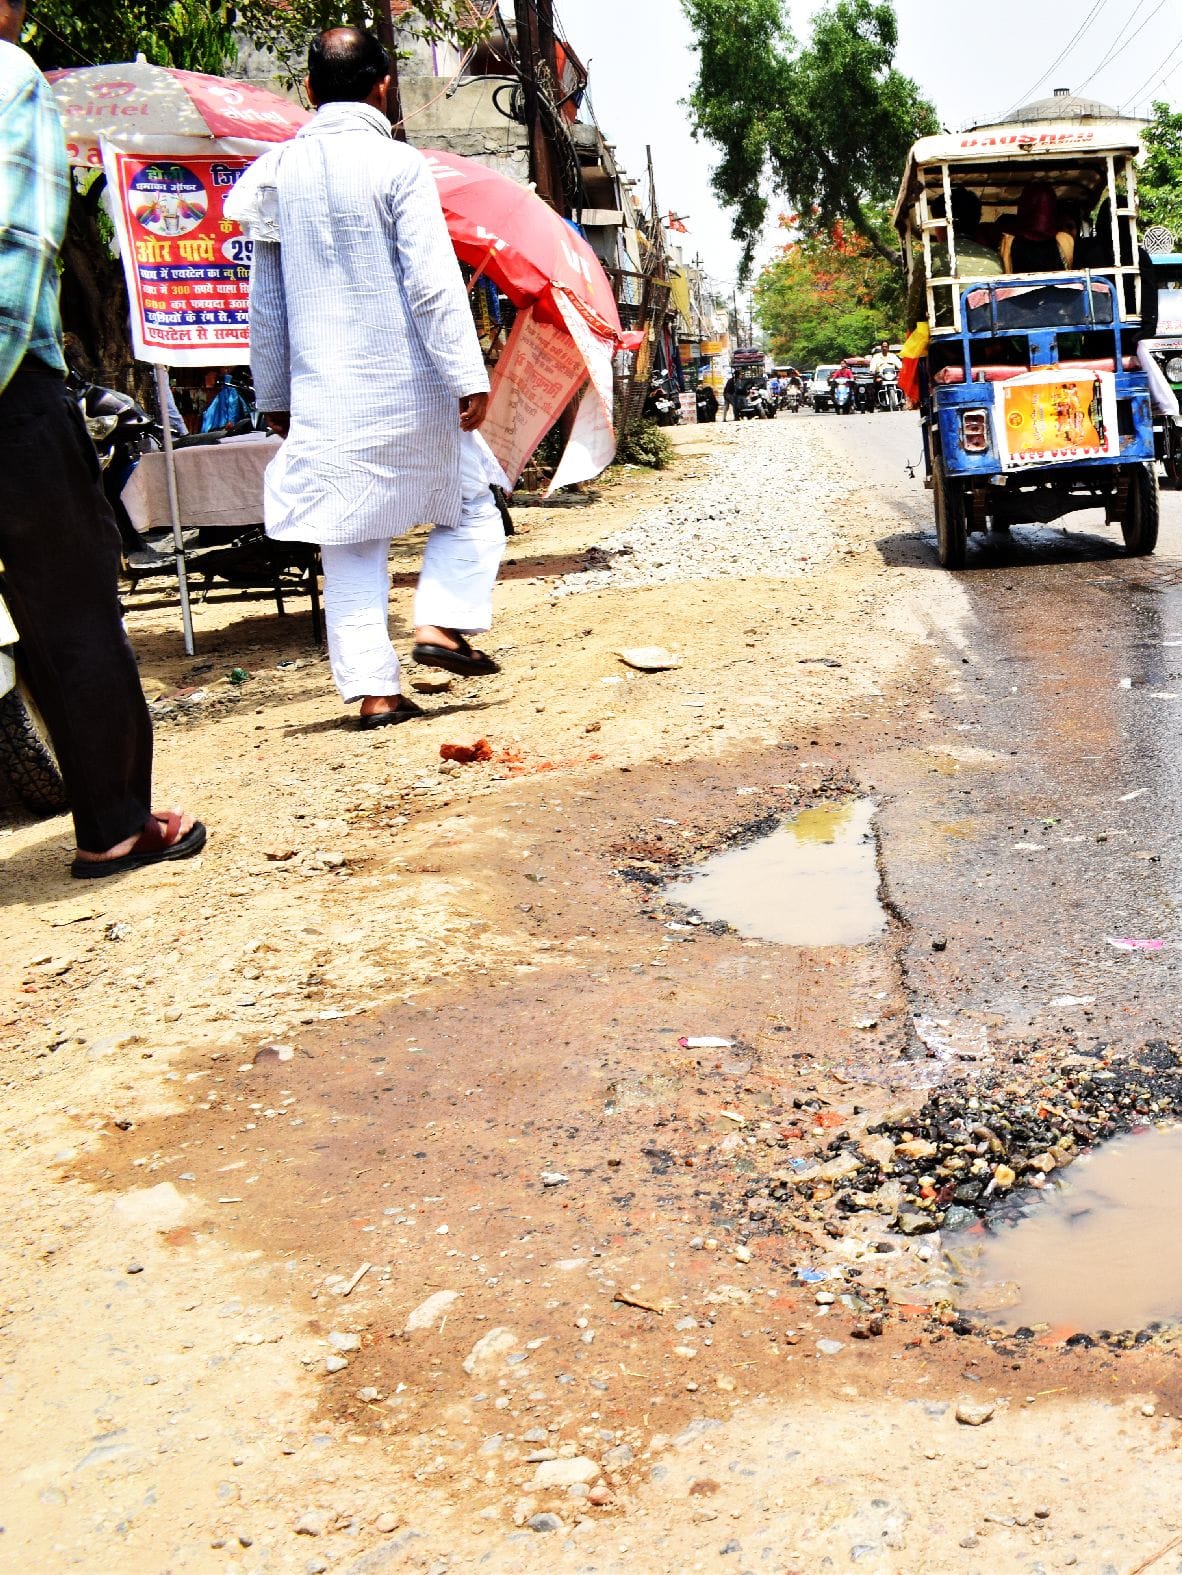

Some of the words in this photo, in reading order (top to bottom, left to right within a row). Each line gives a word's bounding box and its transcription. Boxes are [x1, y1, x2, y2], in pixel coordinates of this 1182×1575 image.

[65, 102, 149, 117] airtel
[146, 166, 184, 180] होली
[136, 183, 167, 191] धमाका
[136, 235, 171, 262] और
[177, 234, 216, 262] पायें
[160, 267, 169, 279] में
[171, 267, 204, 279] एयरटेल
[207, 268, 220, 278] का
[237, 267, 250, 278] सि
[216, 284, 237, 294] वाला
[239, 282, 250, 294] सि
[170, 300, 186, 309] का
[185, 311, 196, 322] के
[201, 310, 215, 321] रंग
[147, 326, 192, 341] एयरटेल
[196, 325, 208, 340] से
